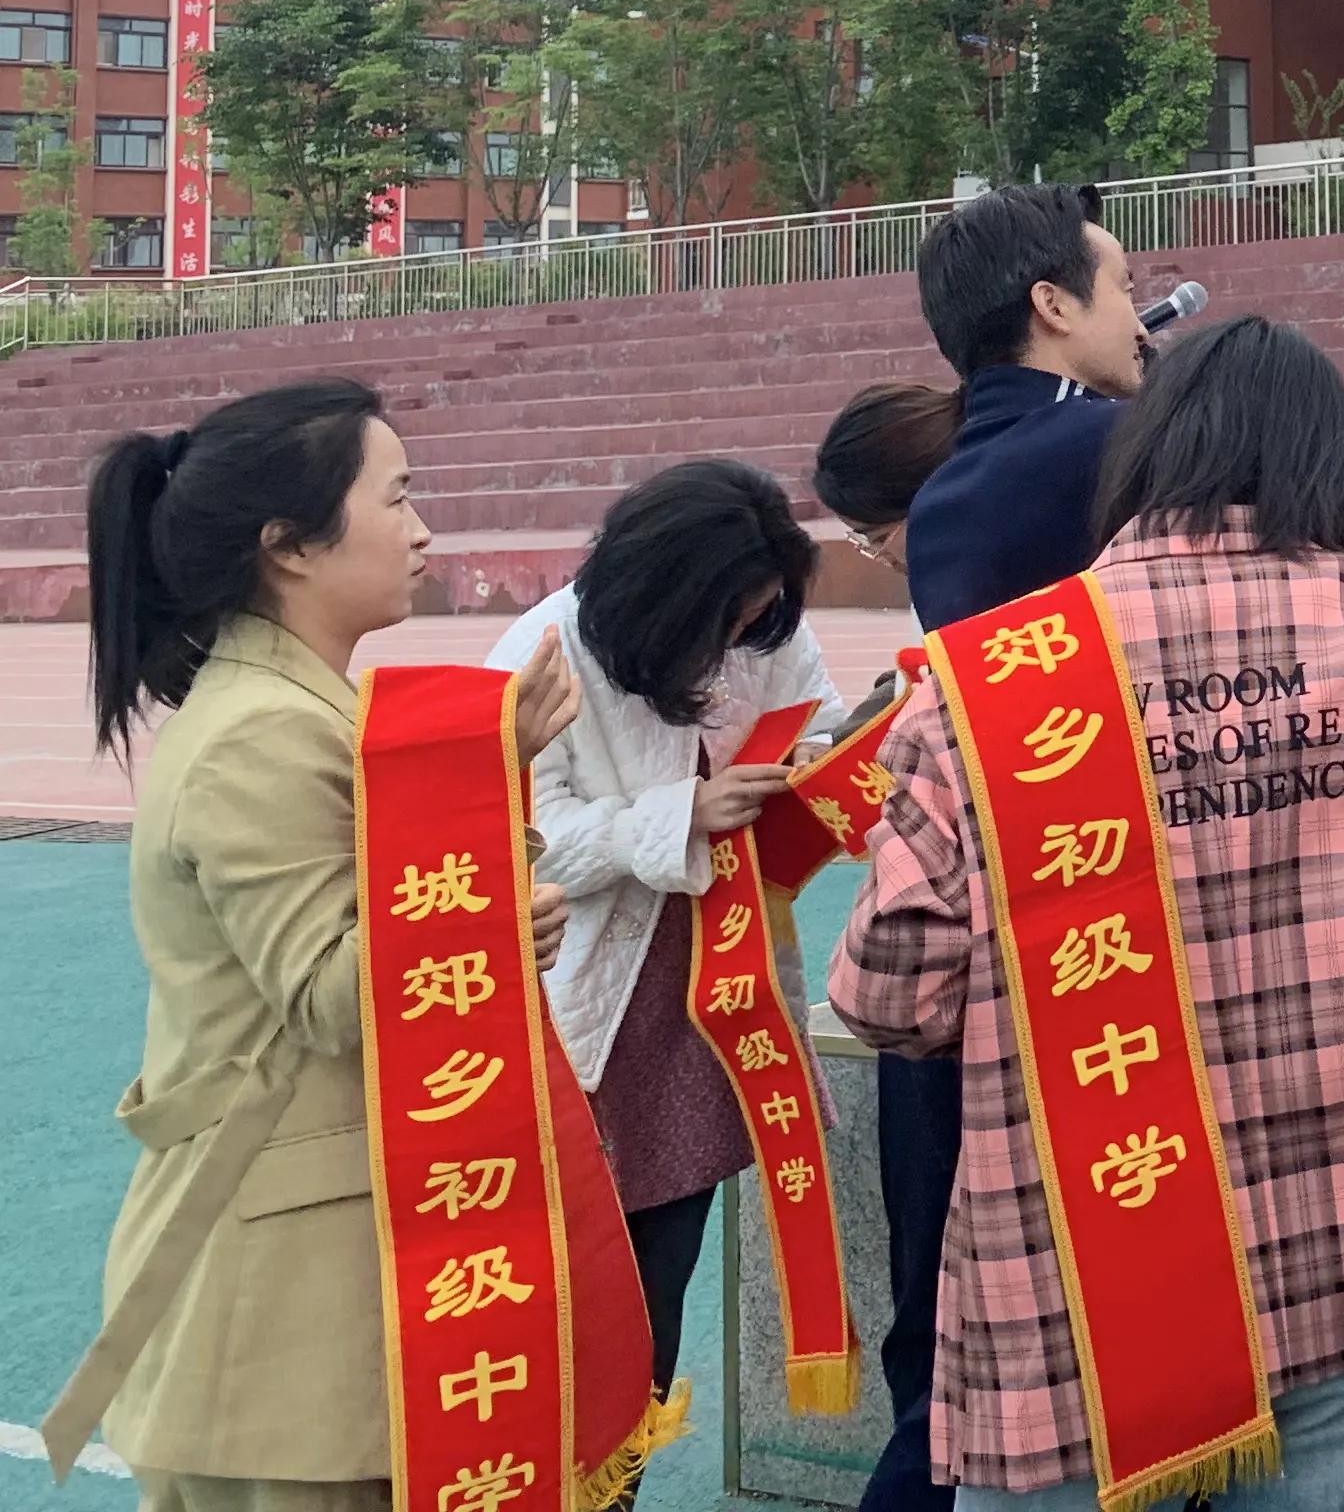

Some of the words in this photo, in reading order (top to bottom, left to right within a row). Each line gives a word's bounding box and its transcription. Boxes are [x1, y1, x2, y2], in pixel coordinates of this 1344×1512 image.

[1164, 662, 1312, 717] ROOM
[1213, 718, 1274, 765] OF
[981, 586, 1188, 1209] 郊乡初级中学
[390, 851, 536, 1512] 城郊乡初级中学
